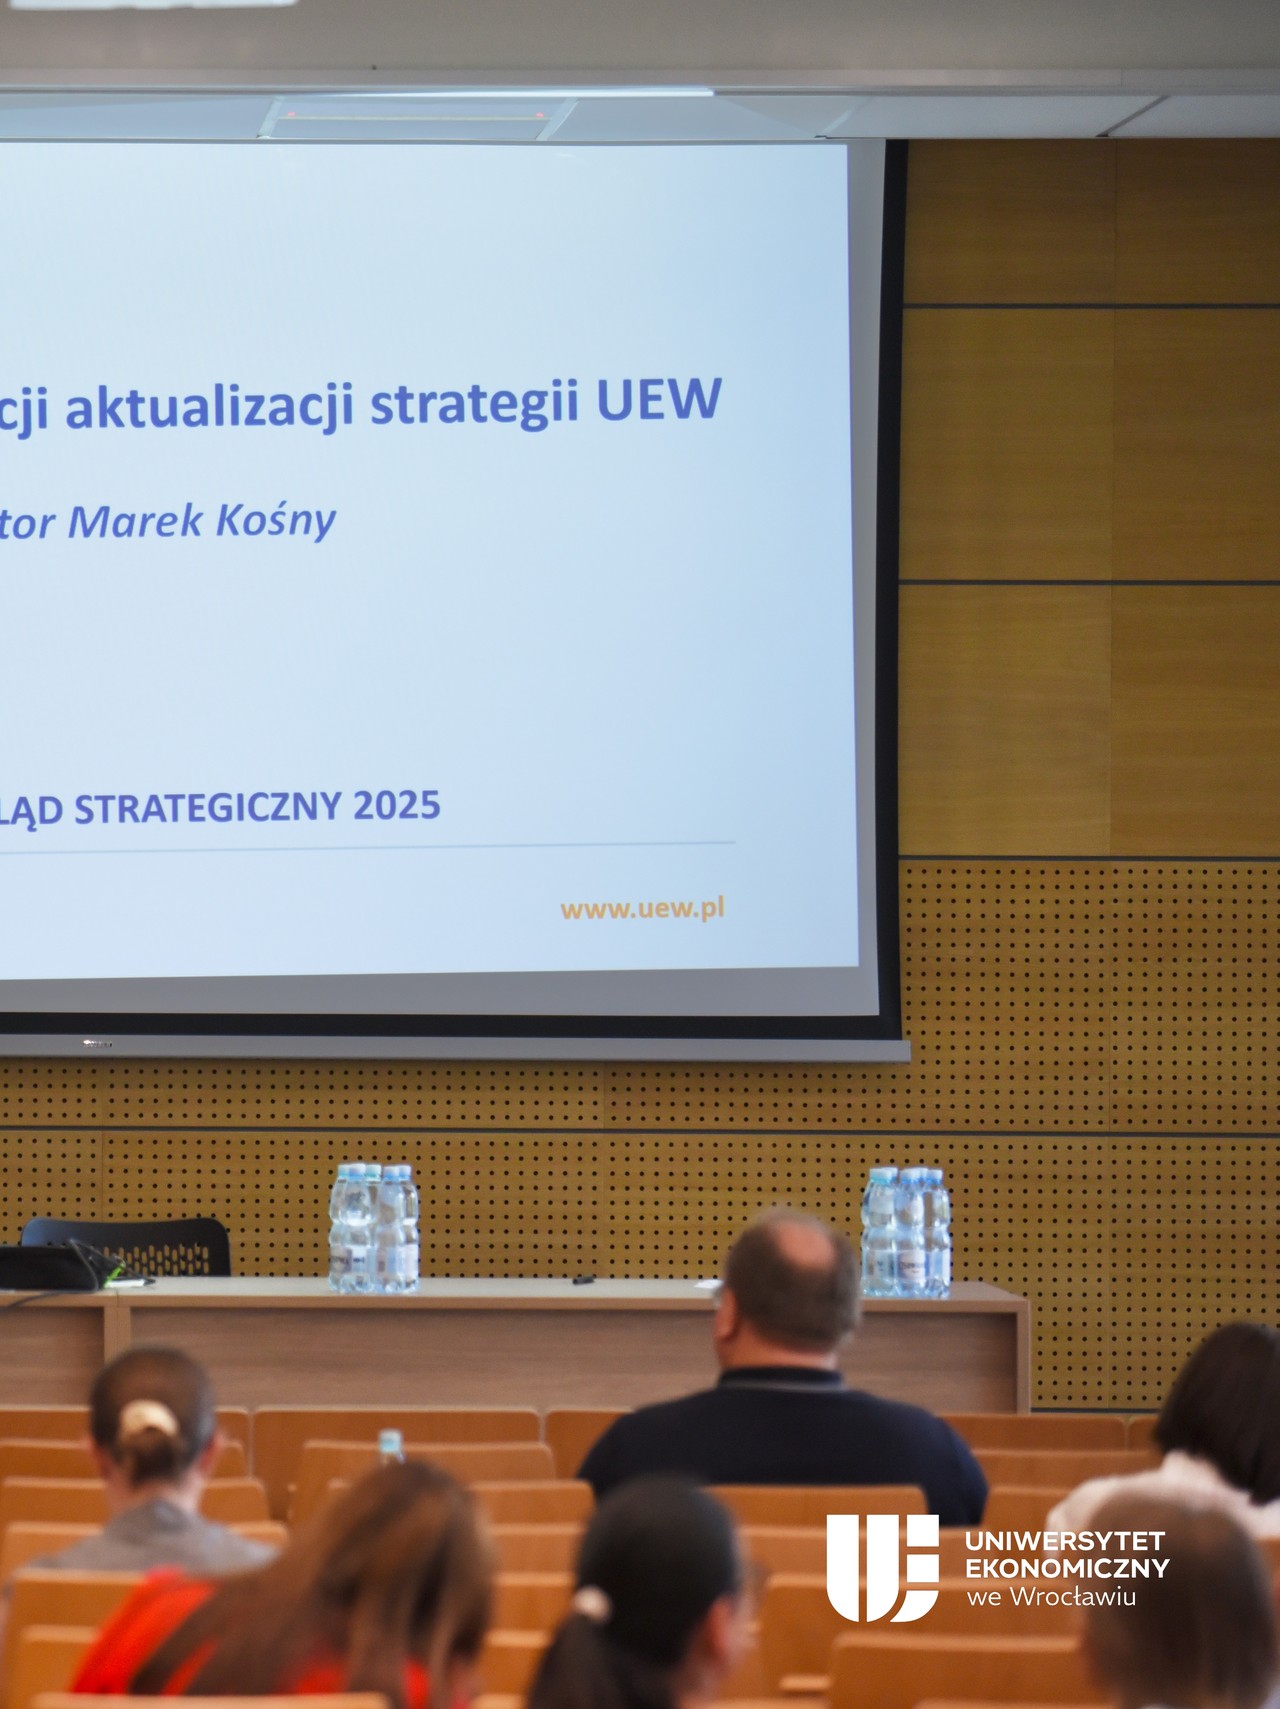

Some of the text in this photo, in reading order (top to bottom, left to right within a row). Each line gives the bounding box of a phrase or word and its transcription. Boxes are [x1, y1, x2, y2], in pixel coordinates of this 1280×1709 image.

[66, 382, 352, 436] aktualizacji
[372, 378, 577, 432] strategii
[599, 378, 722, 421] UEW
[68, 502, 204, 538] Marek
[217, 500, 337, 543] Kośny
[75, 792, 342, 824] STRATEGICZNY
[354, 790, 440, 820] 2025
[561, 895, 725, 923] www.uew.pl
